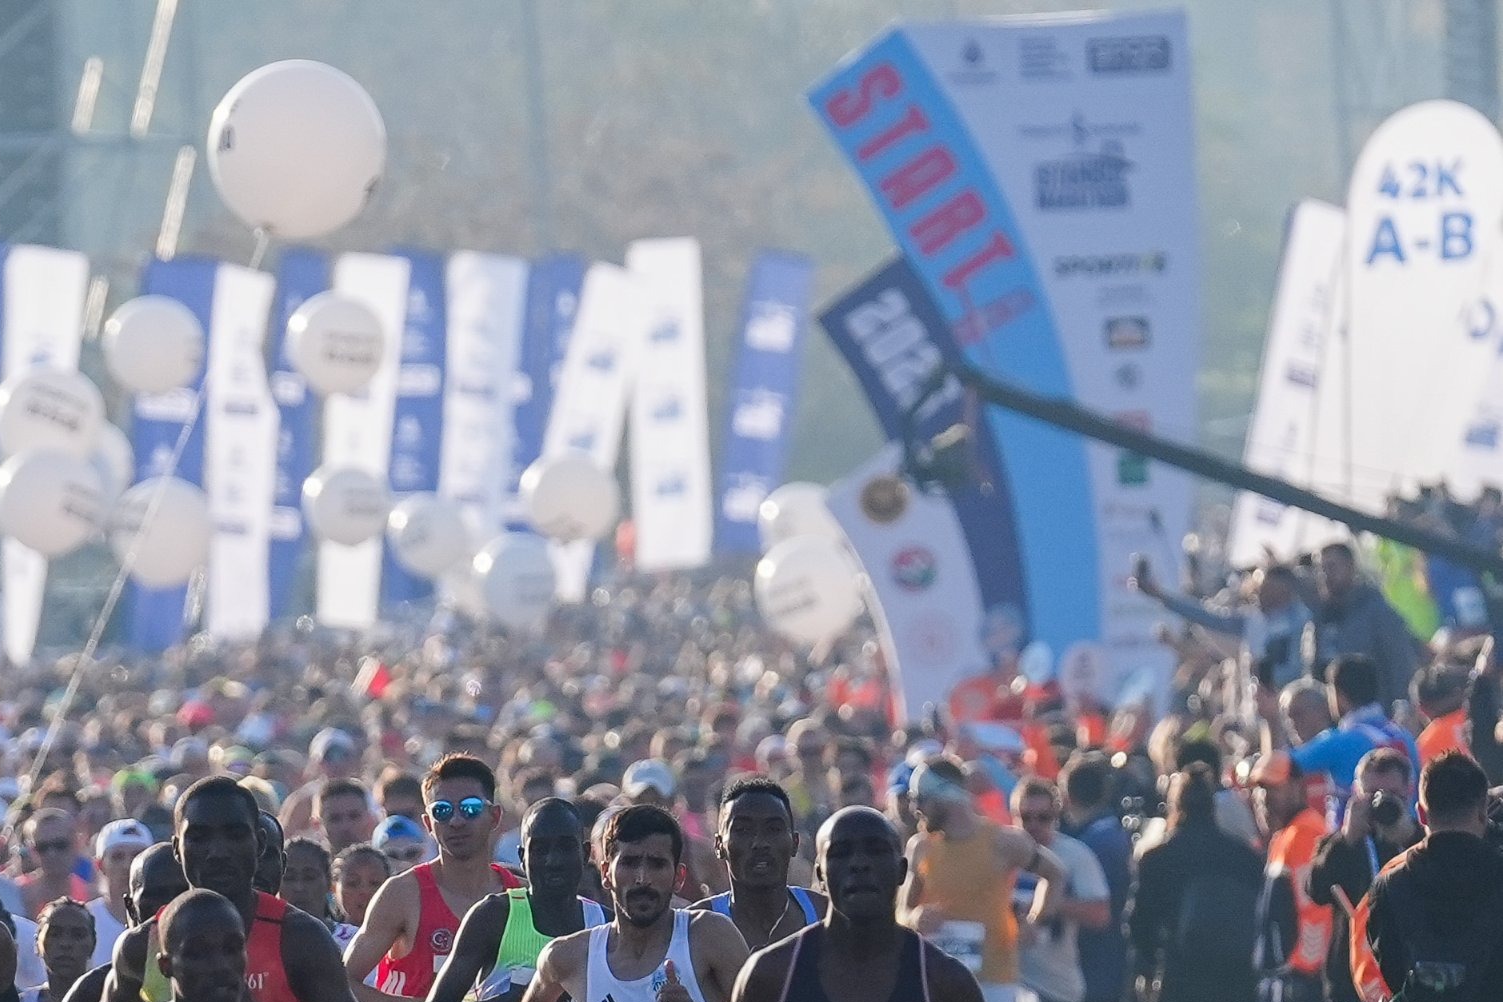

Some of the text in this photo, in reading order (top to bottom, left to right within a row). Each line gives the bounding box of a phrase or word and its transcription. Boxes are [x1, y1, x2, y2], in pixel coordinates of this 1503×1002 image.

[824, 62, 1017, 292] START
[1378, 160, 1462, 199] 42K
[1364, 211, 1476, 265] A-B
